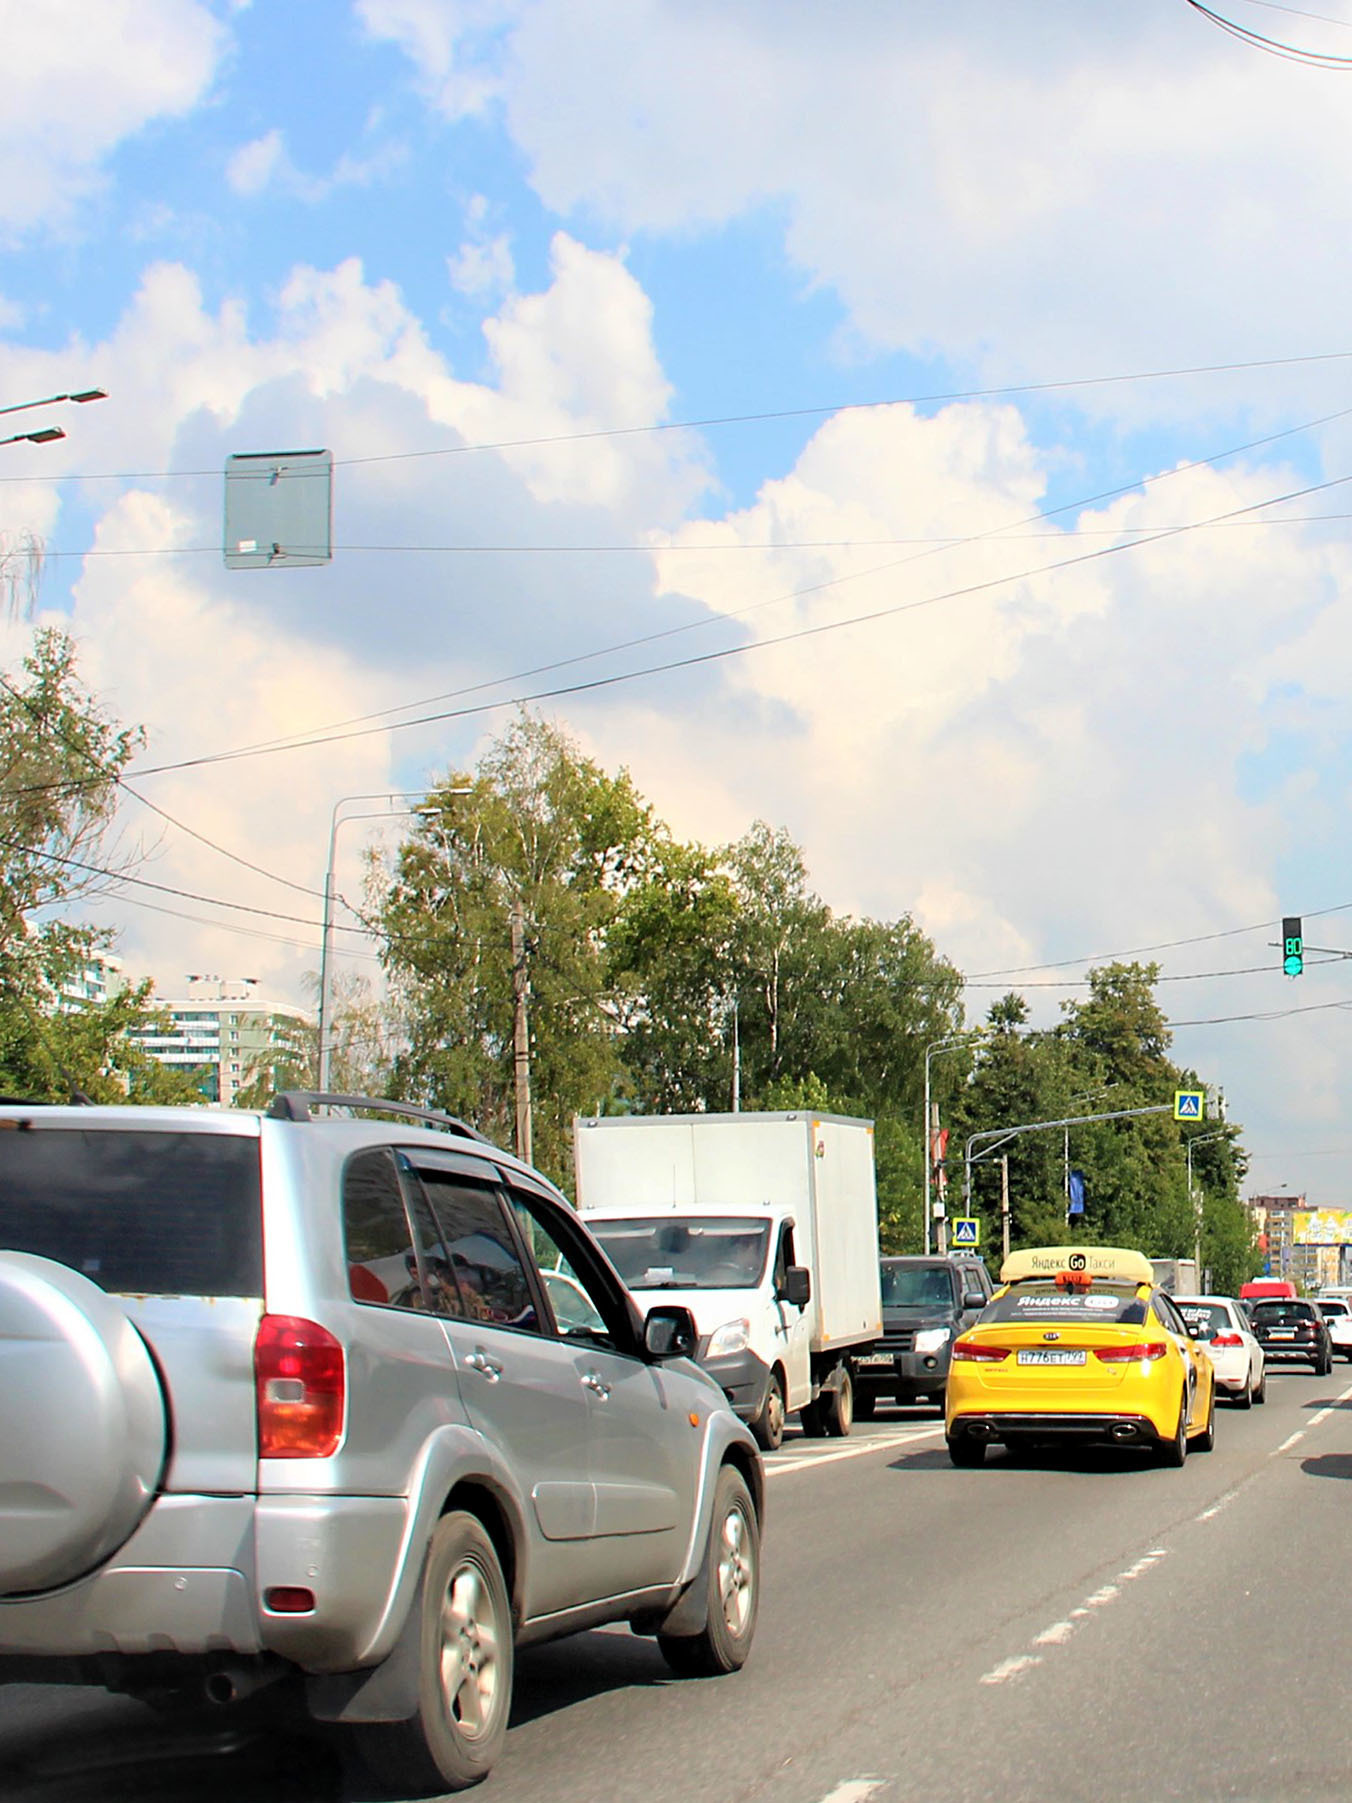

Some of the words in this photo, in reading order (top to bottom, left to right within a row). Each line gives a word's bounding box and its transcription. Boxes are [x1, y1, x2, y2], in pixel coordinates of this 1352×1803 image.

[1286, 937, 1302, 955] 80
[1032, 1256, 1065, 1269] Яндекс
[1070, 1255, 1085, 1269] Go
[1090, 1256, 1115, 1268] Такси
[1017, 1296, 1081, 1306] Яндекс
